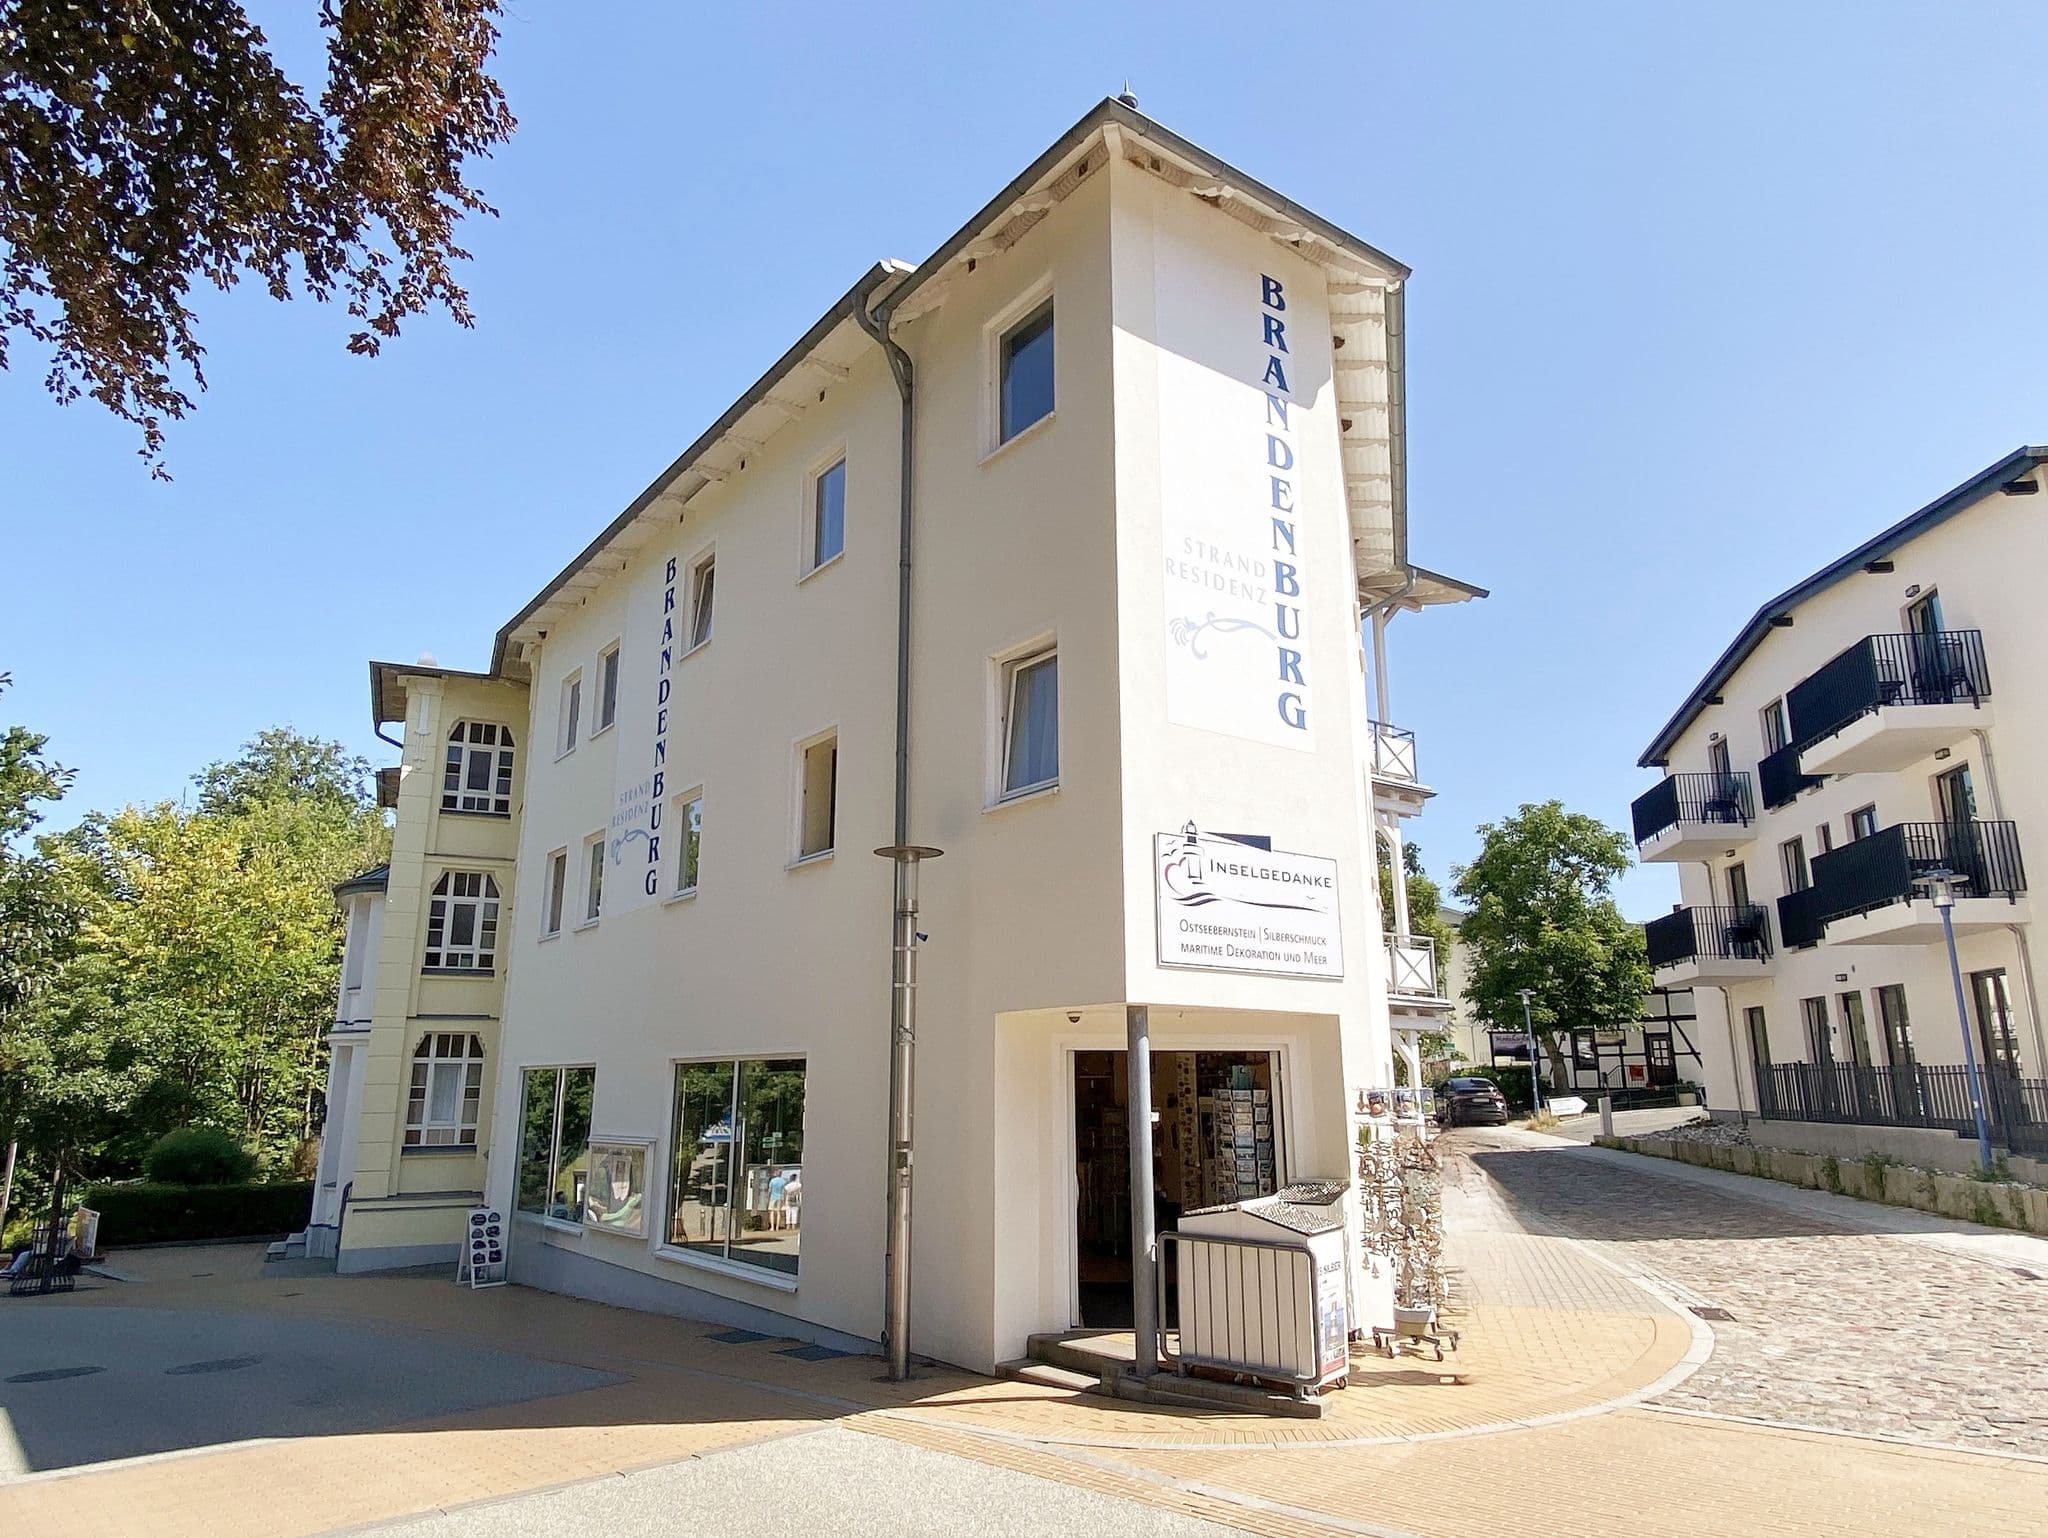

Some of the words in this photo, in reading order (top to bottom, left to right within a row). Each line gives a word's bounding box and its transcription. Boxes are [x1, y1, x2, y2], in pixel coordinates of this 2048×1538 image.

[1260, 272, 1307, 730] BRANDENBURG
[1184, 537, 1265, 578] STRAND
[1165, 557, 1267, 605] RESIDENZ
[645, 557, 677, 896] BRANDENBURG
[1210, 858, 1332, 888] INSELGEDANKE
[1179, 918, 1256, 939] OSTSEEBERNSTEIN
[1263, 928, 1327, 947] SILBERSCHMUCK
[1180, 943, 1223, 956] MARITIME
[1226, 943, 1281, 961] DEKORATION
[1283, 953, 1301, 963] UND
[1303, 951, 1328, 965] MEER
